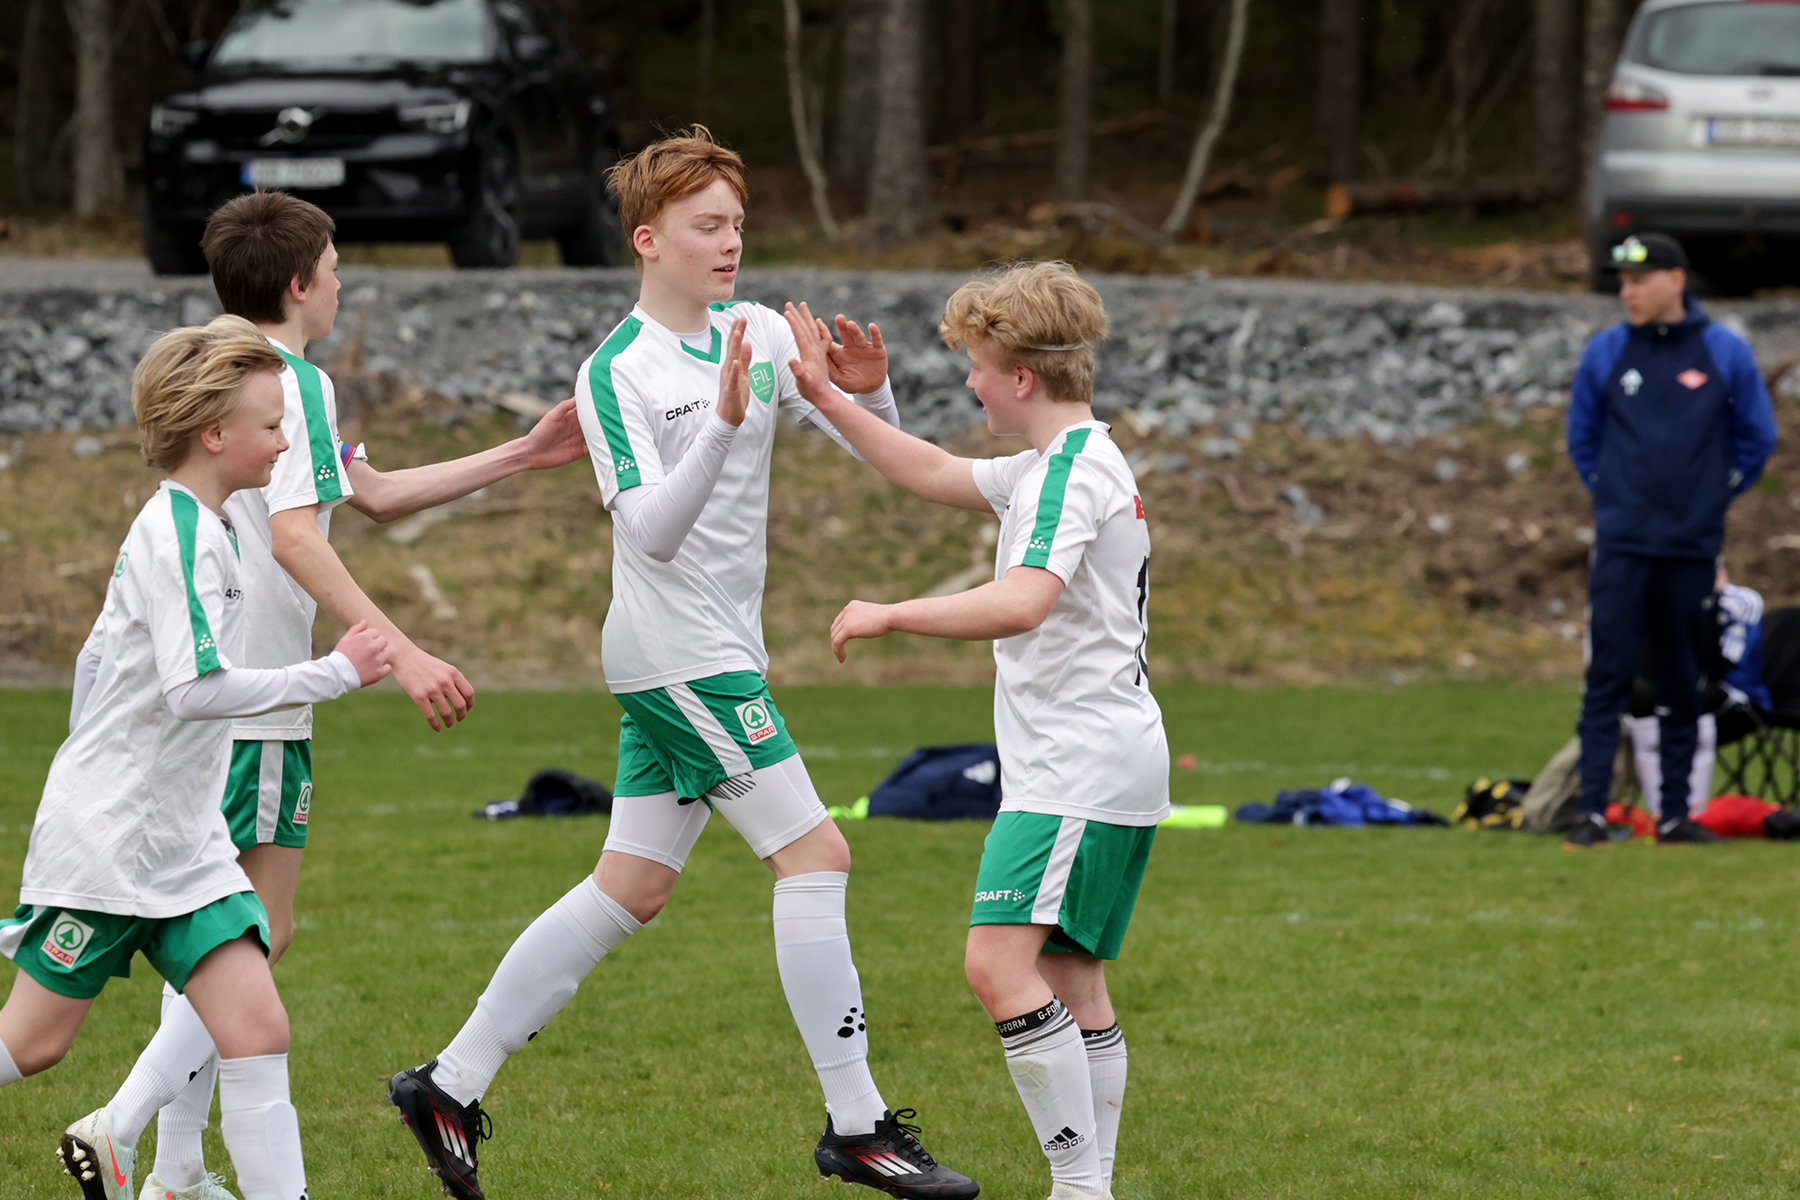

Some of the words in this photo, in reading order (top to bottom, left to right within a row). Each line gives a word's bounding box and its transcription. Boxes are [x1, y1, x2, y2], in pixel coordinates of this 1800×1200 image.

[751, 368, 772, 387] FIL
[750, 726, 775, 741] SPAR
[974, 889, 1012, 903] CRAFT
[44, 941, 75, 965] SPAR
[1043, 1134, 1085, 1151] adidas
